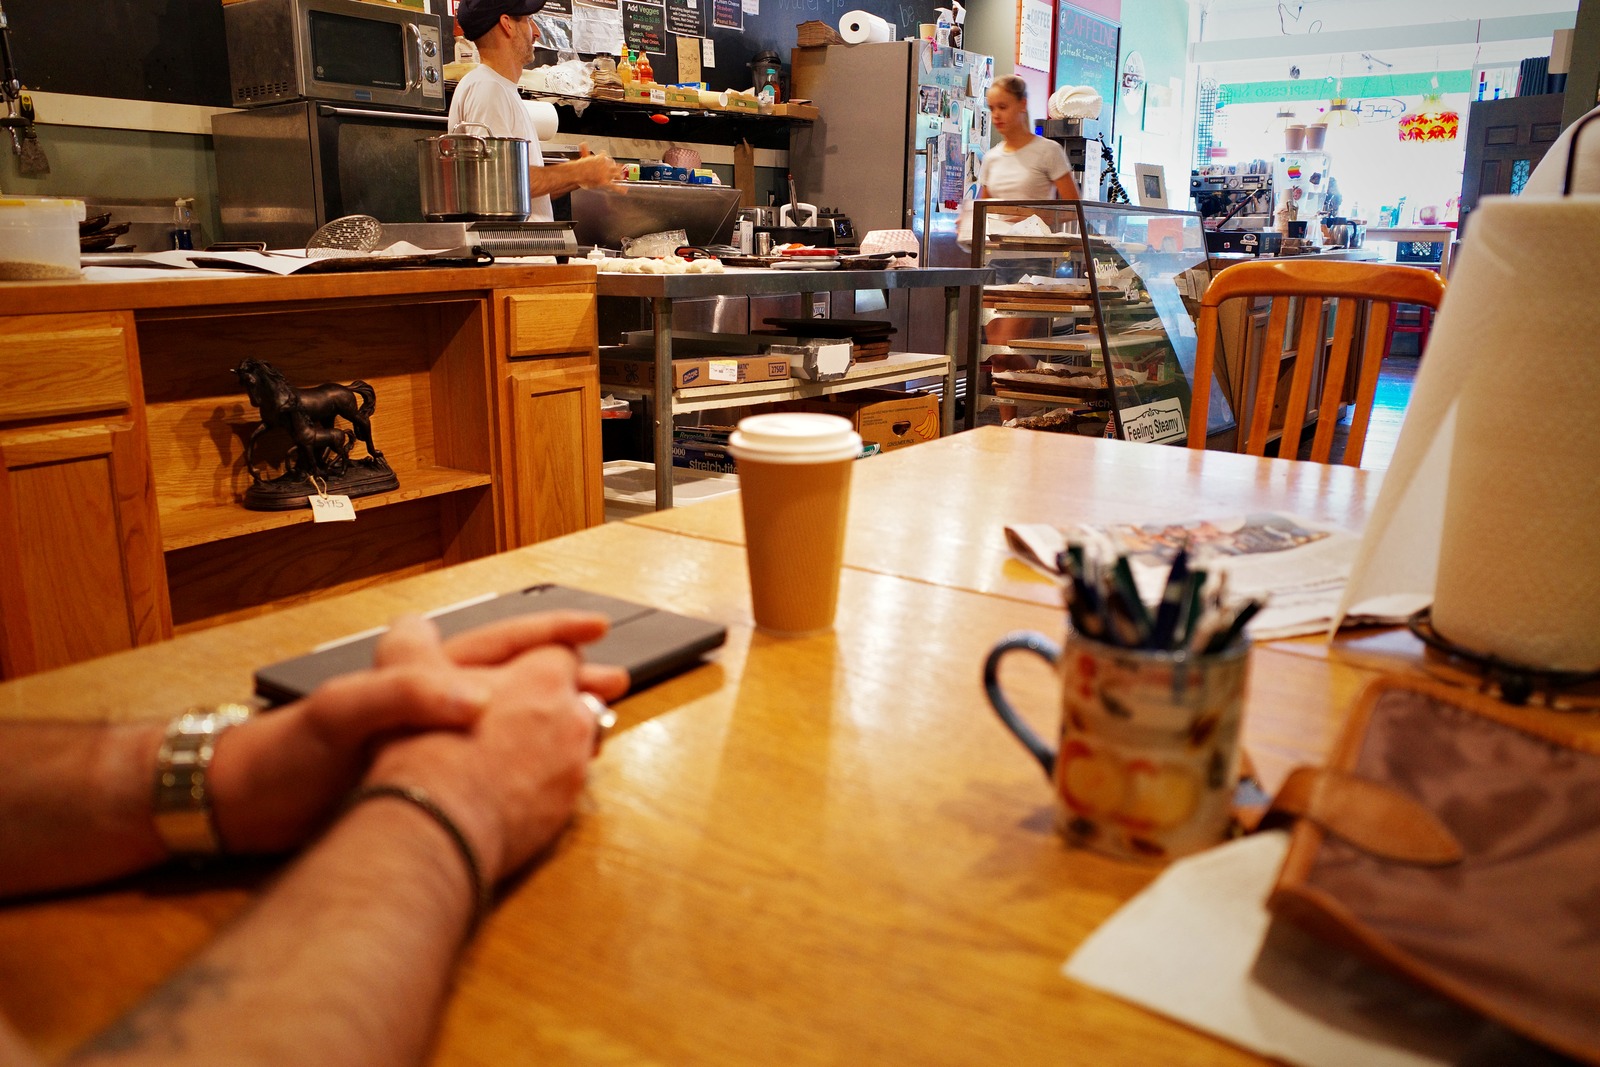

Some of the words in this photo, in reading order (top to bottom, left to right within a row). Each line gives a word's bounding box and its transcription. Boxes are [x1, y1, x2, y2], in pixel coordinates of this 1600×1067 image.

[627, 4, 638, 12] Add
[638, 5, 659, 15] Veggies
[1064, 10, 1116, 48] CAFFEINE
[1126, 424, 1154, 441] Feeling
[1153, 417, 1179, 434] Steamy
